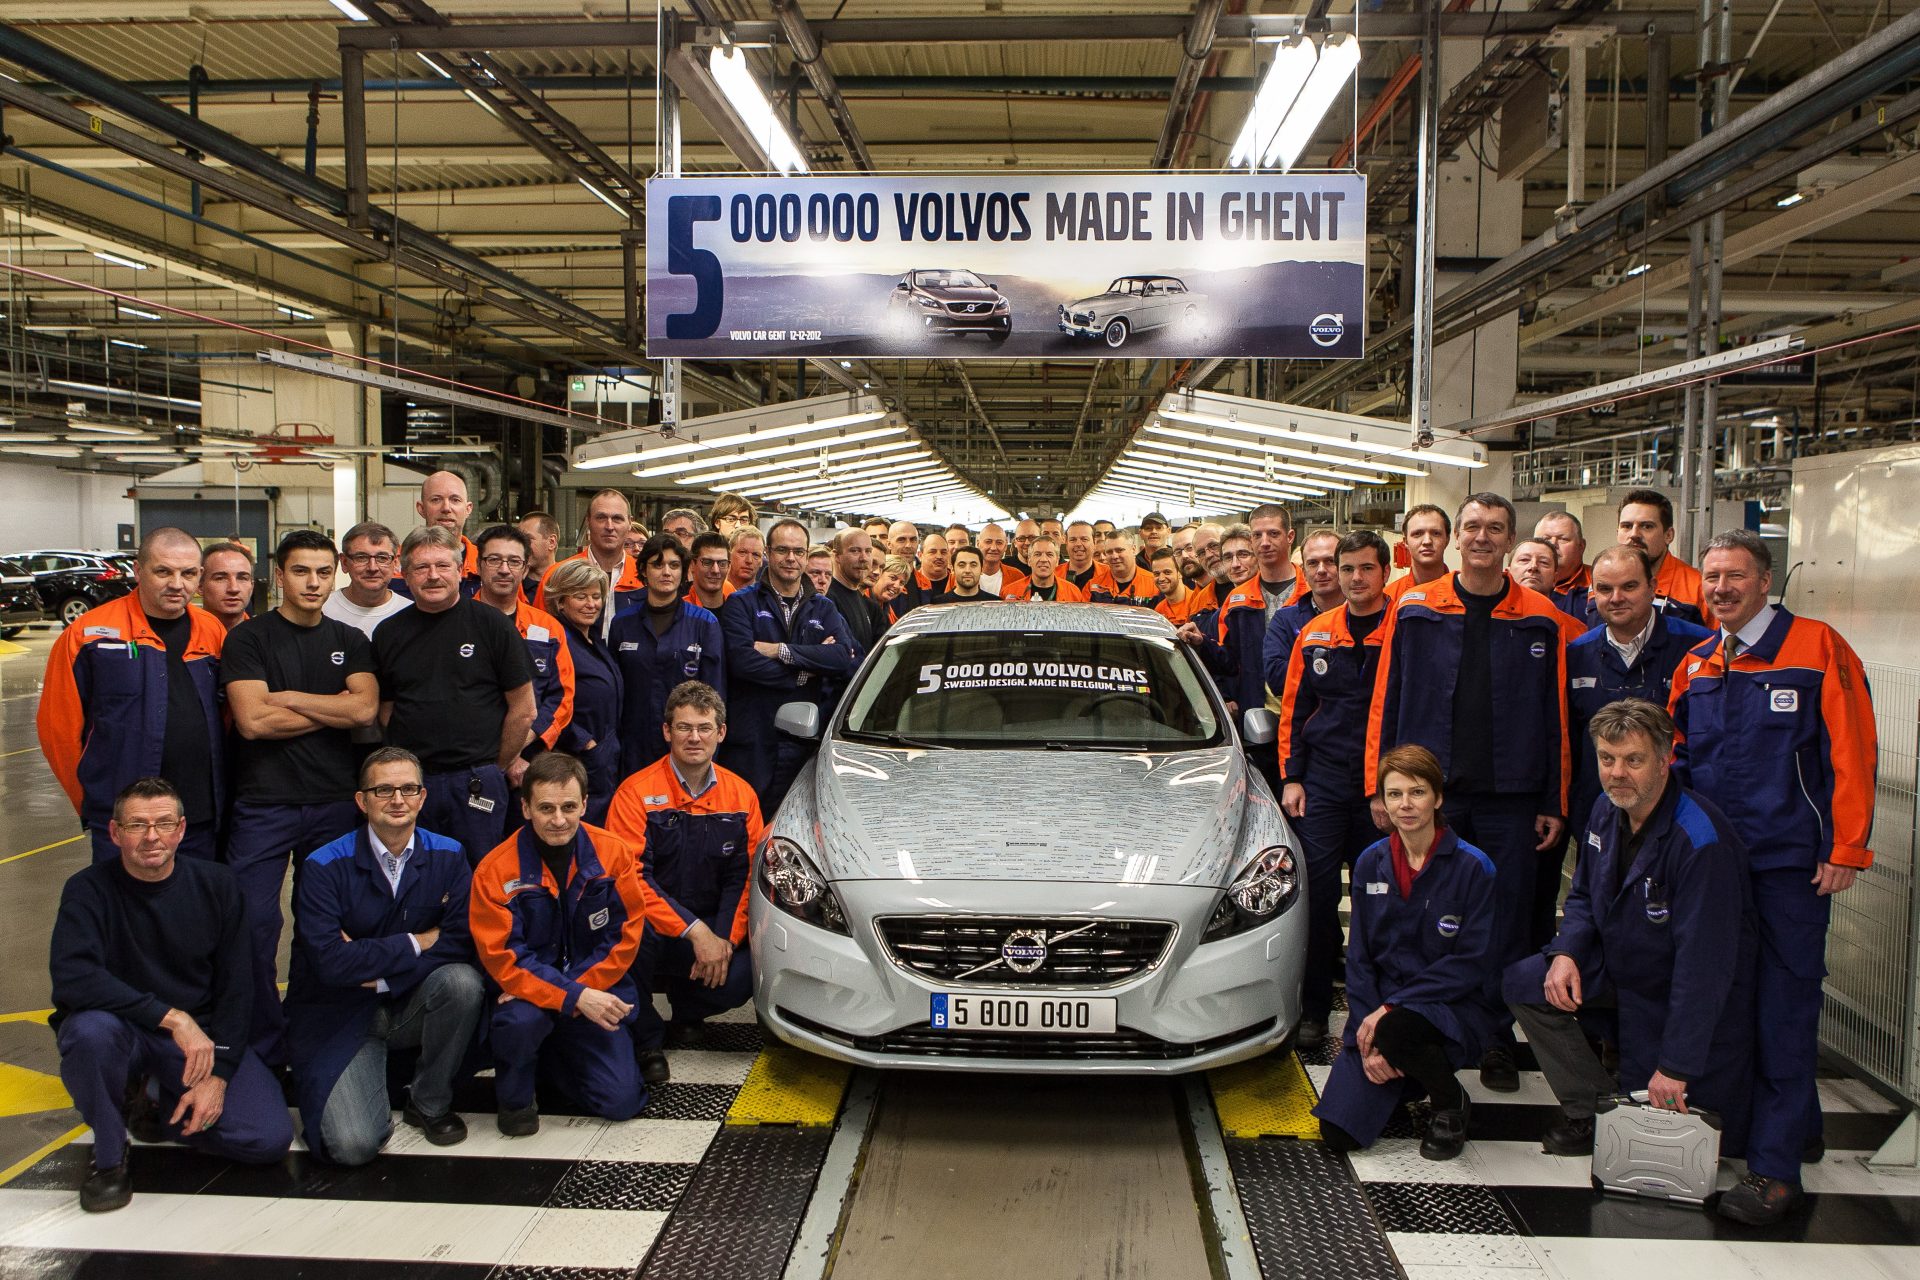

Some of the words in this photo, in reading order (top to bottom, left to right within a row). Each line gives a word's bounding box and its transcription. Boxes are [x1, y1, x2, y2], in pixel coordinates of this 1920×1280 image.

[666, 195, 724, 340] 5
[894, 192, 1032, 242] VOLVOS
[1046, 192, 1152, 241] MADE
[1166, 192, 1204, 241] IN
[1219, 191, 1346, 241] GHENT
[730, 330, 752, 341] VOLVO
[752, 330, 767, 341] CAR
[768, 330, 786, 341] GENT
[790, 330, 822, 341] 12-12-2012
[917, 664, 943, 694] 5
[1033, 662, 1093, 679] VOLVO
[1097, 666, 1148, 683] CARS
[943, 679, 988, 689] SWEDISH
[988, 678, 1028, 687] DESIGN.
[1029, 679, 1058, 687] MADE
[1058, 679, 1070, 688] IN
[1070, 680, 1117, 691] BELGIUM.
[1006, 948, 1044, 956] VOLVO
[954, 998, 969, 1026] 5
[935, 1013, 945, 1026] B
